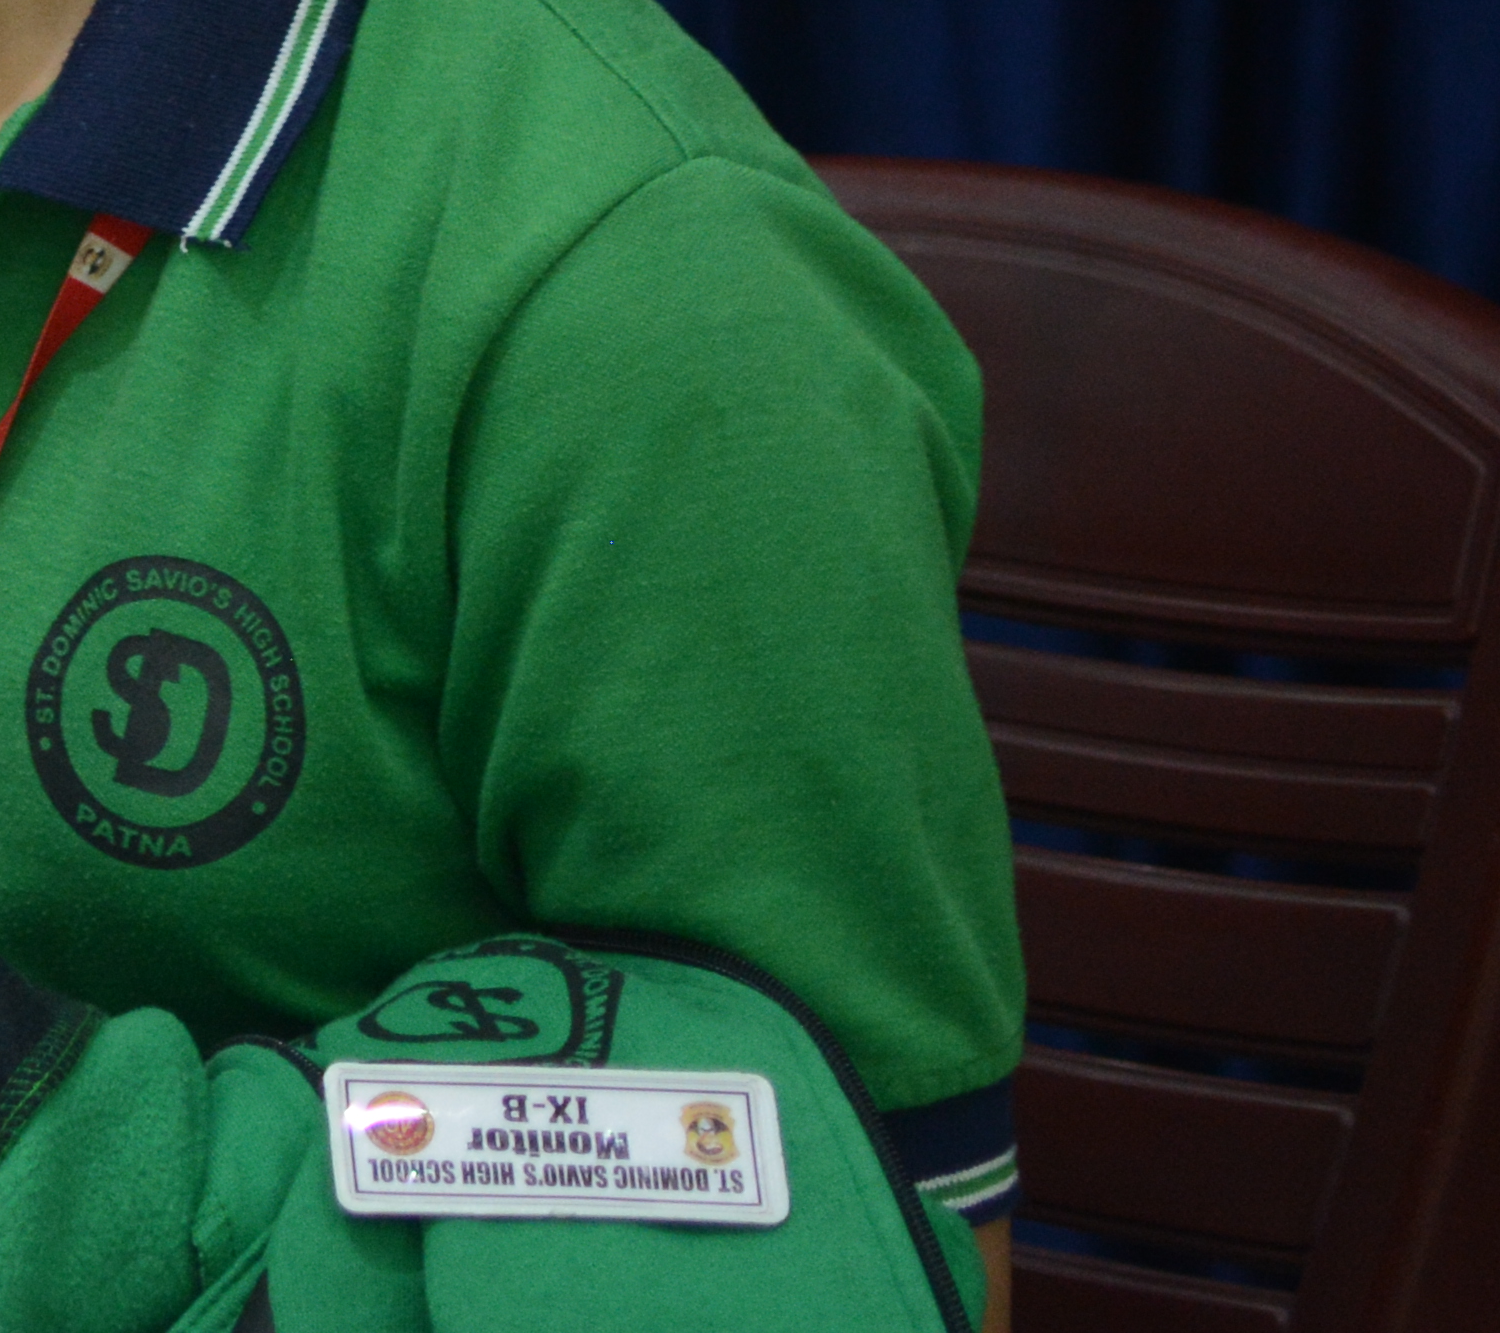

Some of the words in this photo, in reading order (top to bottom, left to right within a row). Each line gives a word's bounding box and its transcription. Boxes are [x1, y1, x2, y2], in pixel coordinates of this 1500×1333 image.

[126, 568, 233, 611] SAVIO'S
[41, 578, 118, 675] DOMINIC
[233, 602, 282, 669] HIGH
[35, 685, 56, 725] ST.
[259, 674, 293, 788] SCHOOL
[75, 802, 193, 858] PATNA
[502, 1093, 590, 1125] IX-B
[467, 1127, 631, 1161] Monitor
[367, 1157, 457, 1185] SCHOOL
[460, 1161, 517, 1186] HIGH
[523, 1162, 610, 1190] SAVIO'S
[613, 1164, 710, 1193] DOMINIC
[710, 1167, 745, 1194] ST.
